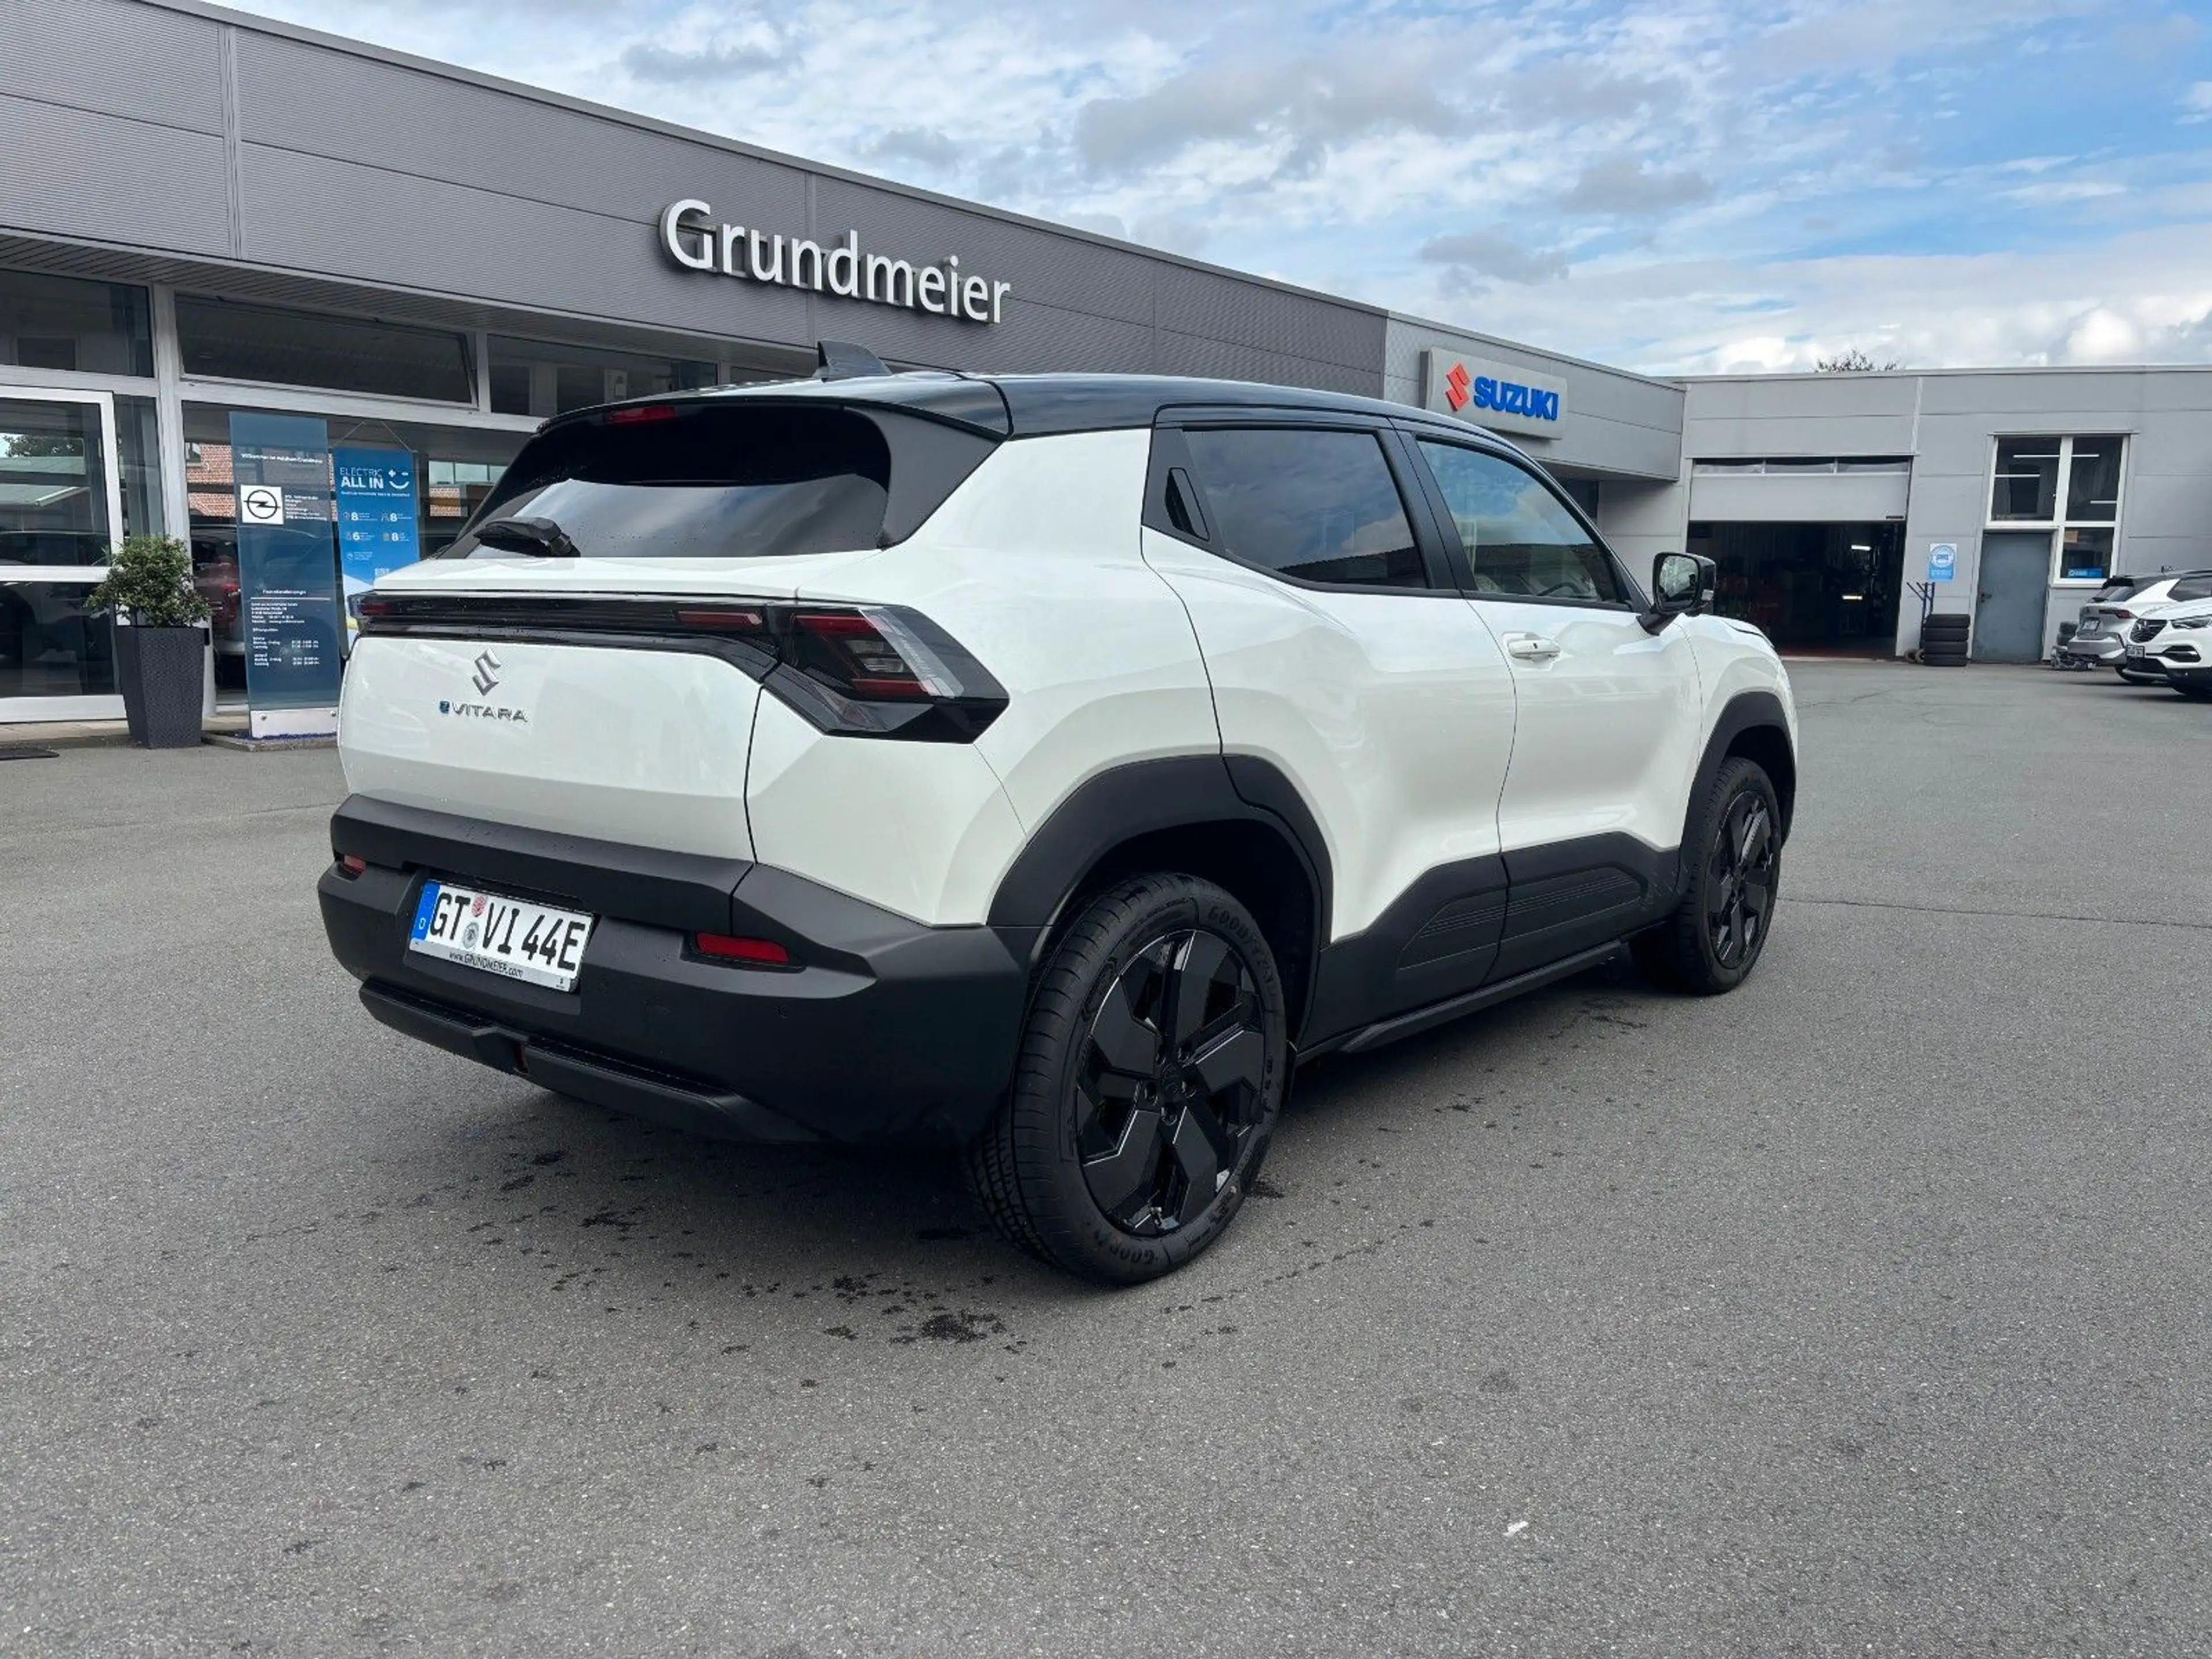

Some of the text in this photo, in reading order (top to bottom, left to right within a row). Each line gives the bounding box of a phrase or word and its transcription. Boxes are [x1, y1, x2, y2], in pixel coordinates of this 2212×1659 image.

[661, 199, 1010, 324] Grundmeier
[1474, 376, 1559, 421] SUZUKI
[340, 467, 384, 478] ELECTRIC
[341, 476, 384, 489] ALL IN
[351, 512, 359, 521] 8
[389, 513, 397, 522] 8
[352, 532, 361, 541] 6
[452, 702, 528, 722] VITARA
[430, 892, 471, 940] GT
[419, 918, 426, 930] D
